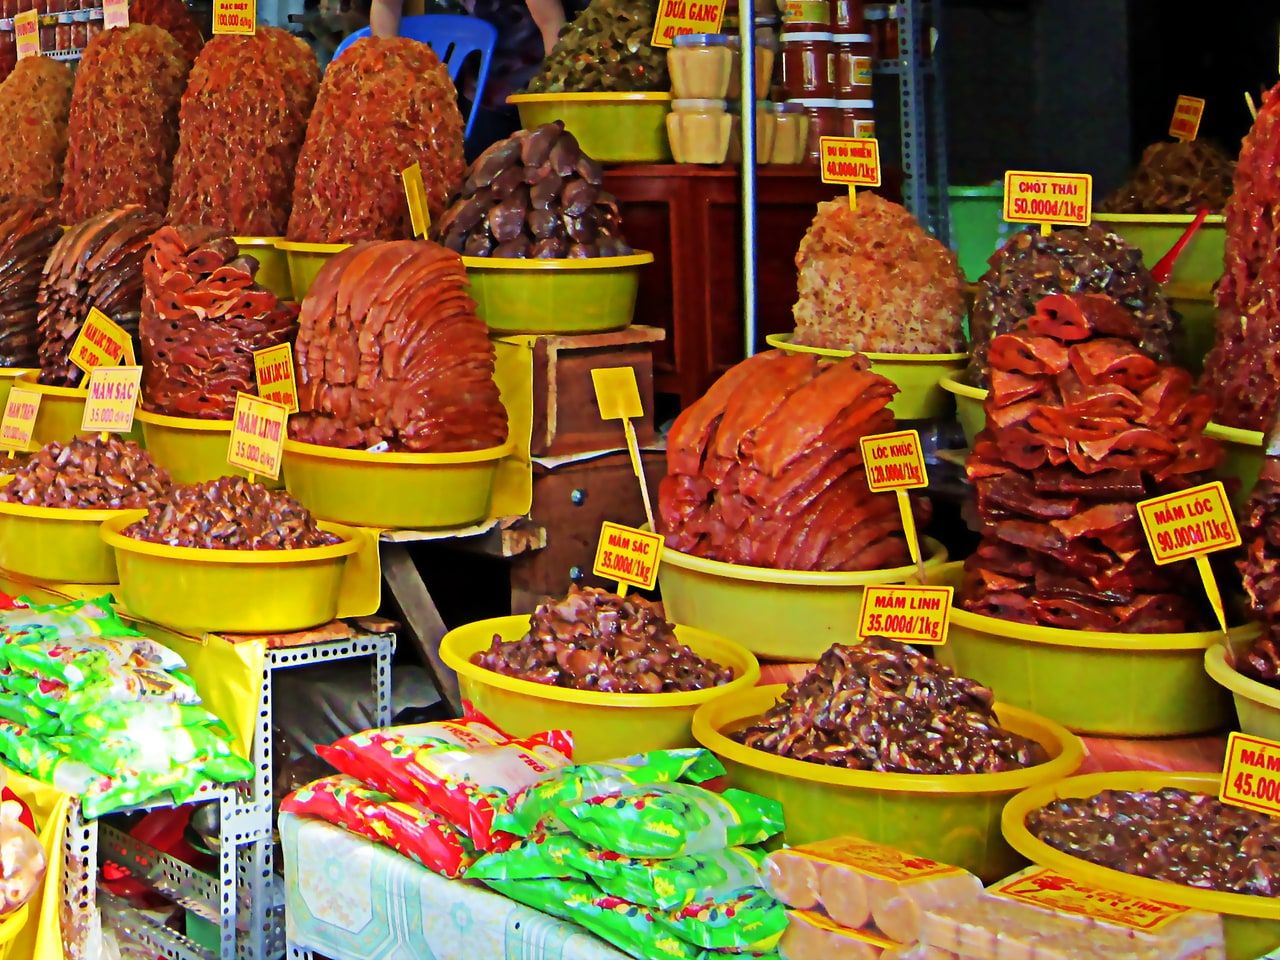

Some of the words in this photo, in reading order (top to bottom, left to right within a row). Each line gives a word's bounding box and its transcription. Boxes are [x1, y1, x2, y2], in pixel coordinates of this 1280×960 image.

[689, 2, 719, 23] GANG
[1014, 197, 1085, 221] 50.000đ/1kg
[1156, 518, 1232, 552] 90.000đ/1kg
[867, 613, 940, 639] 35.000đ/1kg
